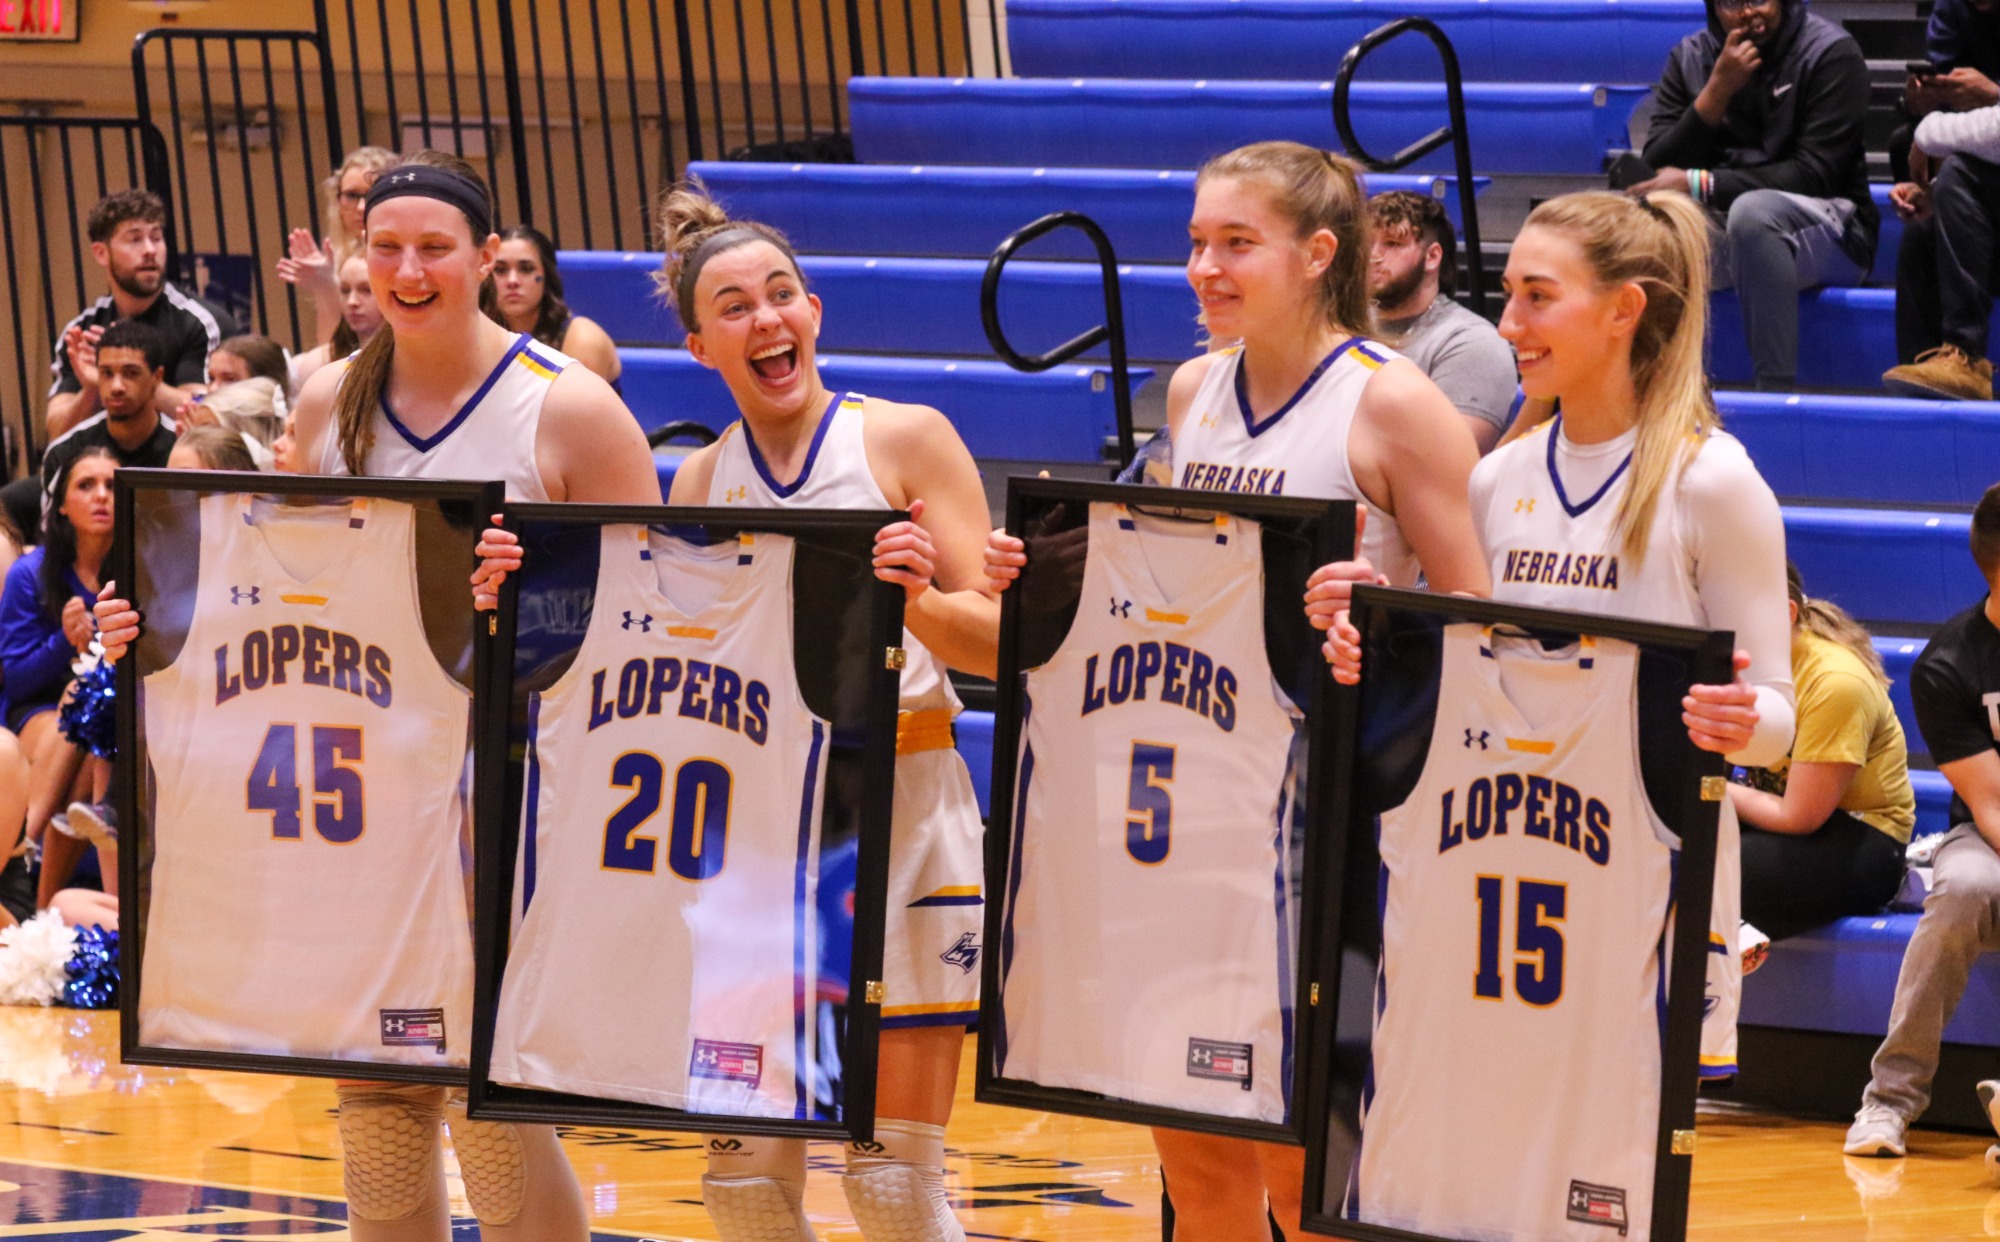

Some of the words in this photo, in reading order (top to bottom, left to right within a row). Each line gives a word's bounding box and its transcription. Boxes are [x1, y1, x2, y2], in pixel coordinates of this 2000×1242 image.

[1180, 461, 1287, 495] NEBRASKA
[1502, 549, 1619, 591] NEBRASKA
[213, 623, 393, 709] LOPERS
[586, 656, 771, 748] LOPERS
[1080, 640, 1238, 733] LOPERS
[245, 721, 367, 847] 45
[600, 749, 735, 884] 20
[1124, 739, 1179, 868] 5
[1438, 772, 1612, 867] LOPERS
[1473, 873, 1569, 1010] 15
